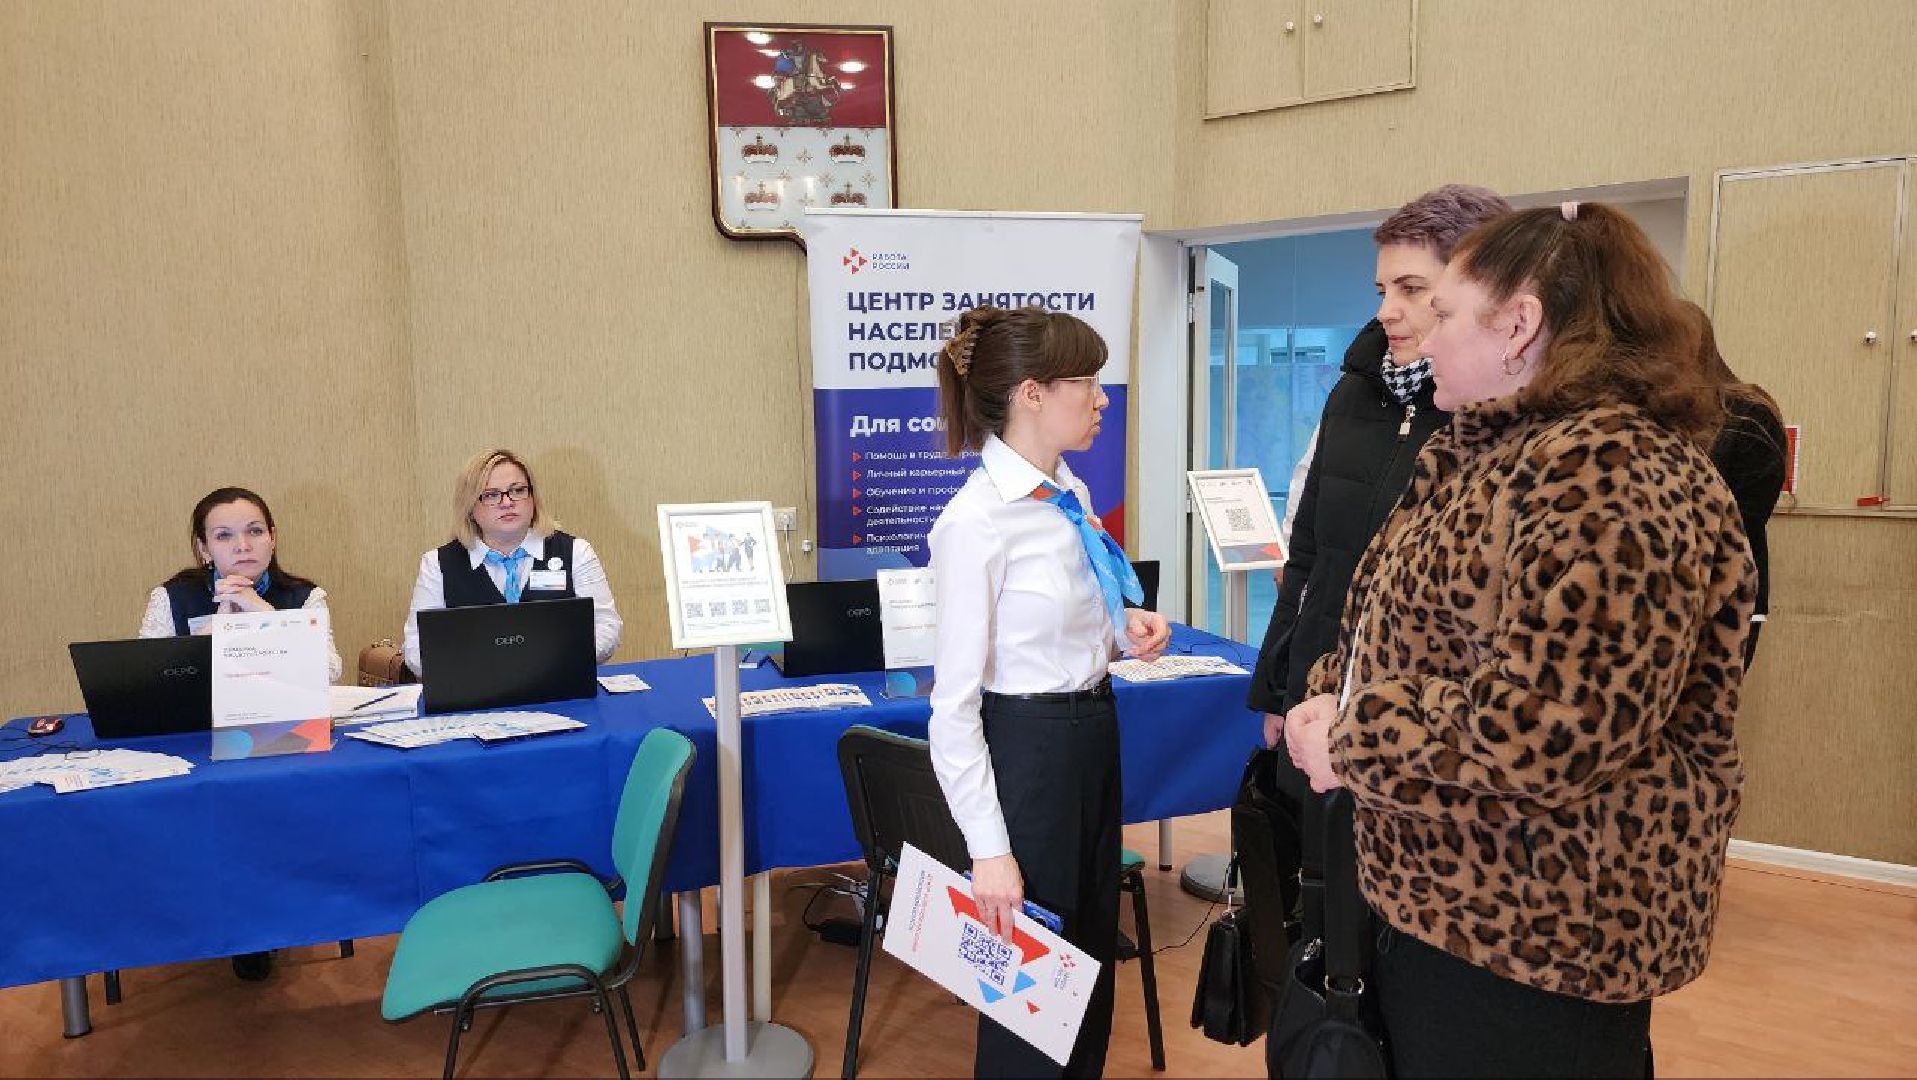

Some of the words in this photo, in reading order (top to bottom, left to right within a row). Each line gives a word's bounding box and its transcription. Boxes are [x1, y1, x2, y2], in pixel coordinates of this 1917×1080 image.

[872, 253, 907, 261] РАБОТА
[872, 262, 910, 270] РОССИИ
[847, 292, 935, 314] ЦЕНТР
[942, 292, 1094, 310] ЗАНЯТОСТИ
[850, 415, 901, 437] Для
[865, 451, 907, 461] Помощь
[867, 468, 907, 478] Личный
[909, 466, 966, 477] карьерный
[866, 487, 917, 498] Обучение
[919, 487, 926, 495] и
[866, 505, 927, 515] Содействие
[866, 544, 920, 555] адаптация
